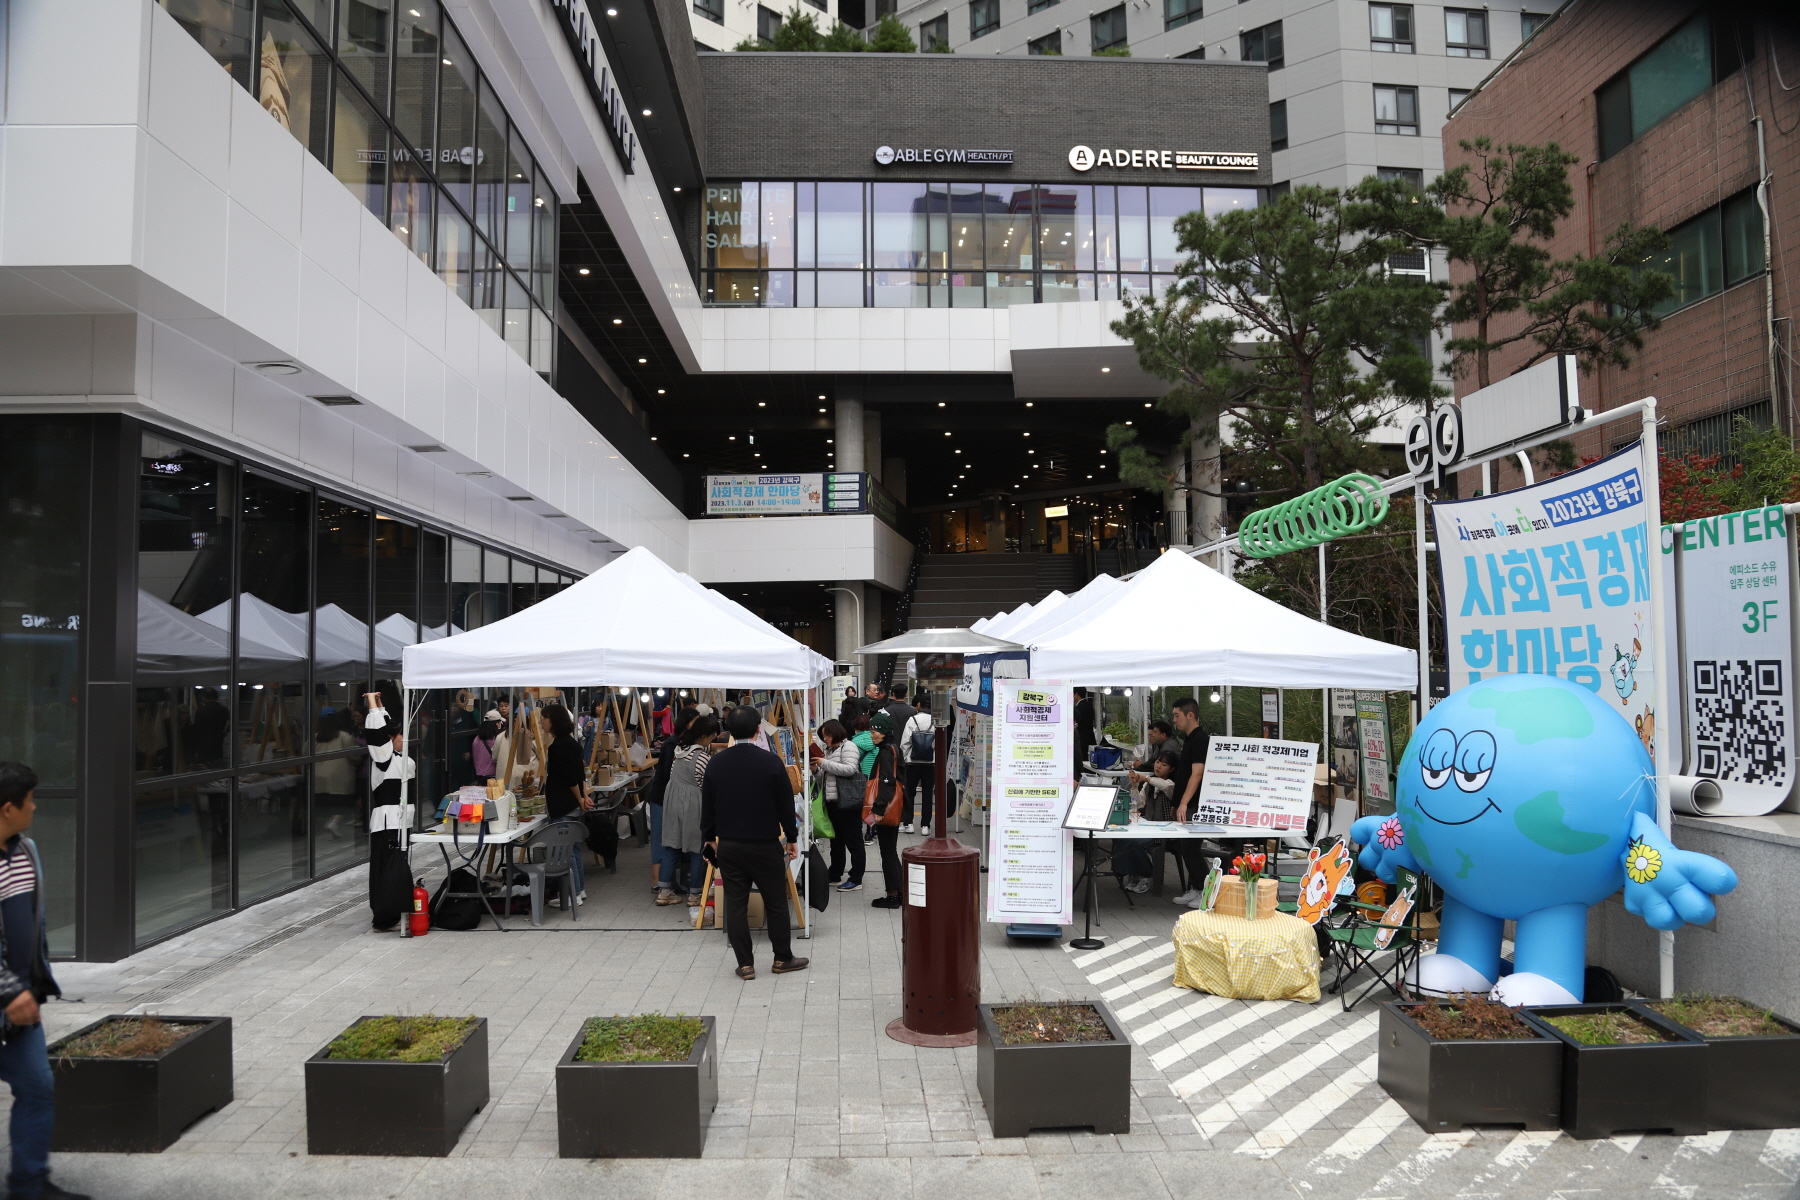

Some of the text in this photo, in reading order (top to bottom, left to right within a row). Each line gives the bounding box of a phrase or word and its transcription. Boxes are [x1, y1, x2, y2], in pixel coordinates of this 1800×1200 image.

[895, 149, 931, 162] ABLE
[934, 149, 966, 163] GYM
[1097, 149, 1173, 168] ADERE
[1176, 155, 1214, 165] BEAUTY
[1217, 155, 1259, 166] LOUNGE
[706, 188, 787, 203] PRIVATE
[706, 211, 753, 226] HAIR
[705, 233, 775, 248] SALON
[711, 485, 800, 498] 사회적경제 한마당
[1545, 473, 1641, 523] 2023년 강북구
[1458, 525, 1496, 541] 사회적경제
[1494, 520, 1521, 536] 이곳에
[1660, 505, 1786, 554] CENTER
[1460, 521, 1650, 617] 사회적경제
[1729, 561, 1777, 575] 에피소드 수유
[1730, 575, 1777, 590] 입주 상담 센터
[1742, 600, 1778, 634] 3F
[1460, 624, 1602, 694] 한마당
[1022, 693, 1044, 702] 강북구
[1016, 706, 1052, 714] 사회적경제
[1019, 714, 1048, 722] 지원센터
[1214, 743, 1240, 752] 강북구
[1241, 744, 1260, 753] 사회
[1200, 805, 1231, 815] #누구나
[1193, 810, 1306, 829] #경품5종 경품이벤트
